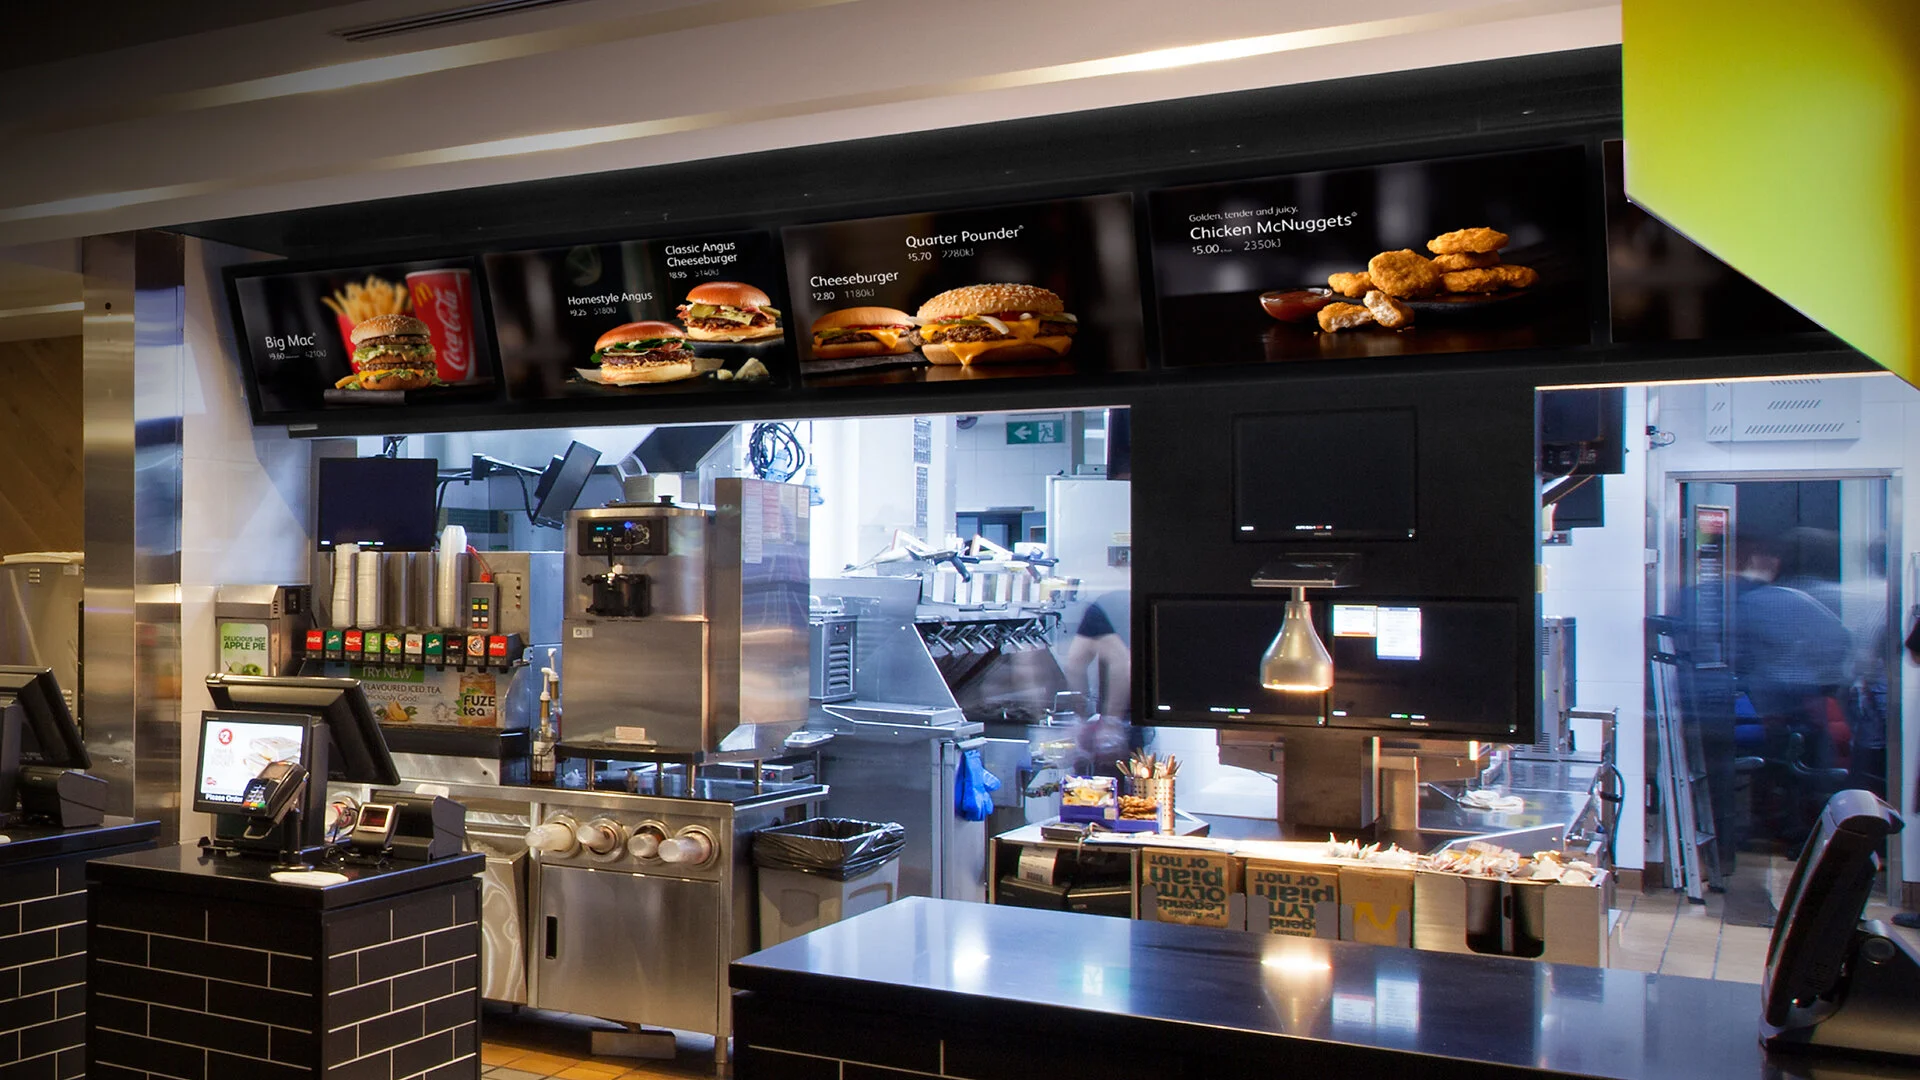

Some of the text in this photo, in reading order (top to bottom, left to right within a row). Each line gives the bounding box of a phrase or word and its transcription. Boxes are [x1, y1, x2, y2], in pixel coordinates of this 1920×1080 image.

[1225, 210, 1253, 220] tender
[1255, 206, 1274, 216] and
[1190, 224, 1252, 240] Chicken
[905, 234, 958, 249] Quarter
[1192, 238, 1282, 255] $5.00 2350kJ
[664, 242, 736, 255] Classic Angus
[666, 254, 738, 267] Cheeseburger
[908, 251, 932, 262] $5.70
[809, 271, 899, 288] Cheeseburger
[567, 292, 653, 306] Homestyle Angus
[812, 291, 836, 301] $2.80
[264, 336, 286, 351] Big
[223, 641, 266, 651] APPLE PIE
[383, 667, 413, 679] NEW
[408, 684, 426, 693] ICED
[463, 695, 496, 706] FUZE
[463, 706, 485, 717] tea
[1187, 857, 1209, 868] or
[1150, 867, 1223, 887] pian
[1296, 875, 1320, 887] or
